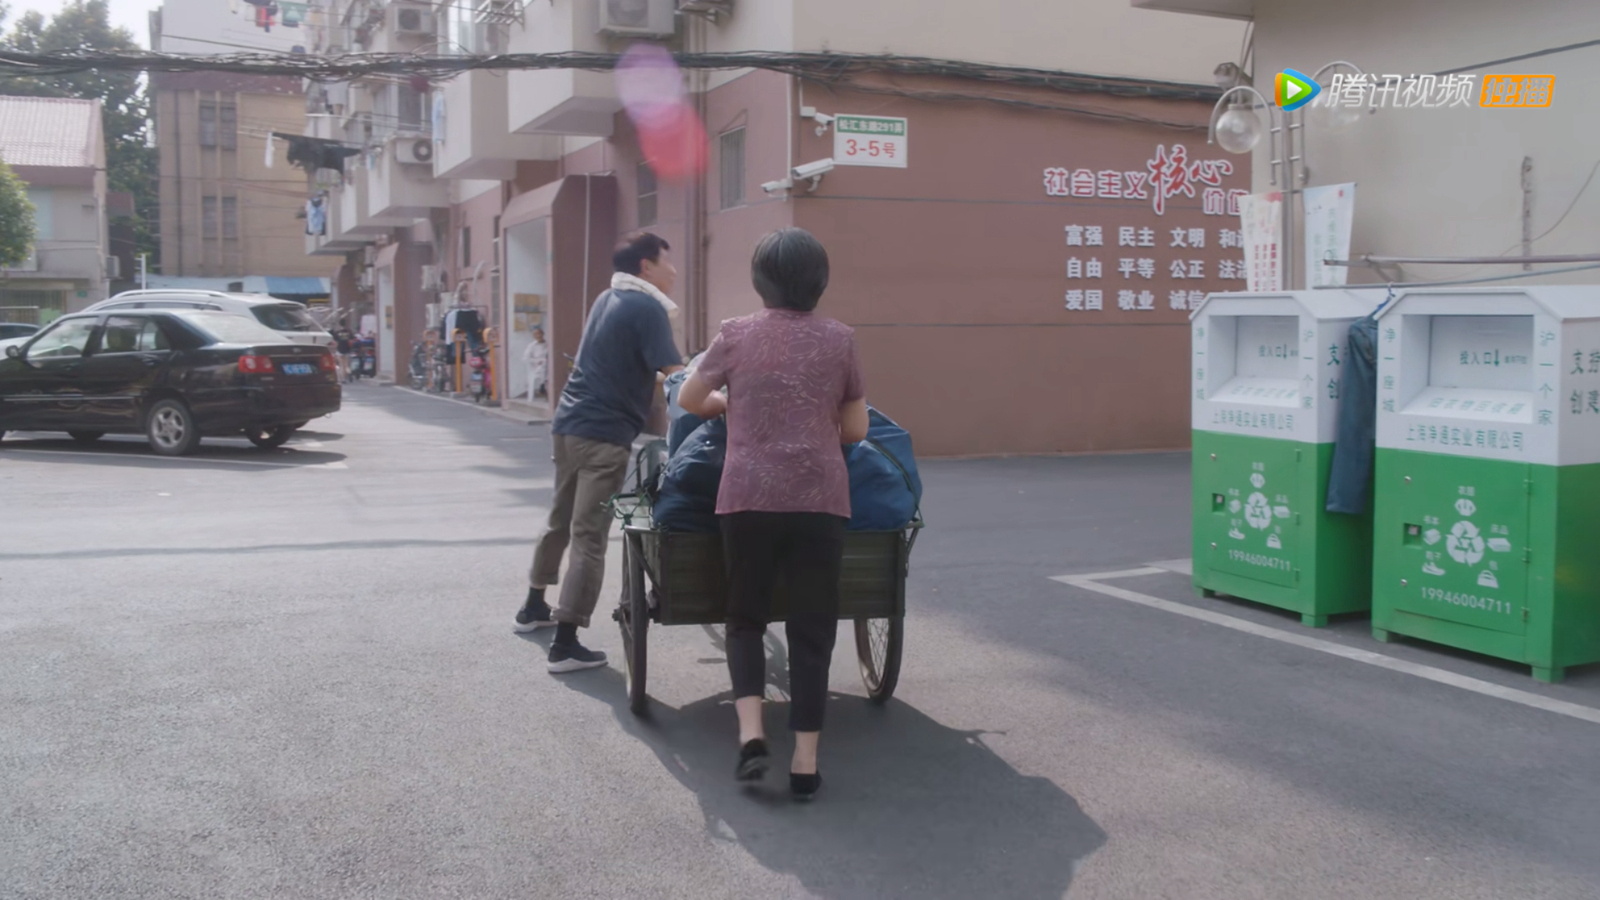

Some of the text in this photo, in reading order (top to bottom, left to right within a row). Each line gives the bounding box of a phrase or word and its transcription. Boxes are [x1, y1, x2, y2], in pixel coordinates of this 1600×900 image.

[846, 139, 896, 158] 3-5号
[1044, 167, 1148, 198] 社会主义
[1146, 144, 1233, 215] 核心
[1064, 225, 1104, 246] 富强
[1118, 227, 1155, 247] 民主
[1169, 228, 1205, 247] 文明
[1066, 258, 1102, 279] 自由
[1118, 259, 1155, 279] 平等
[1169, 260, 1205, 278] 公正
[1065, 289, 1204, 310] 爱国 敬业 诚信
[1460, 350, 1492, 365] 投入口
[1229, 550, 1291, 571] 19946004711
[1421, 587, 1511, 614] 19946004711
